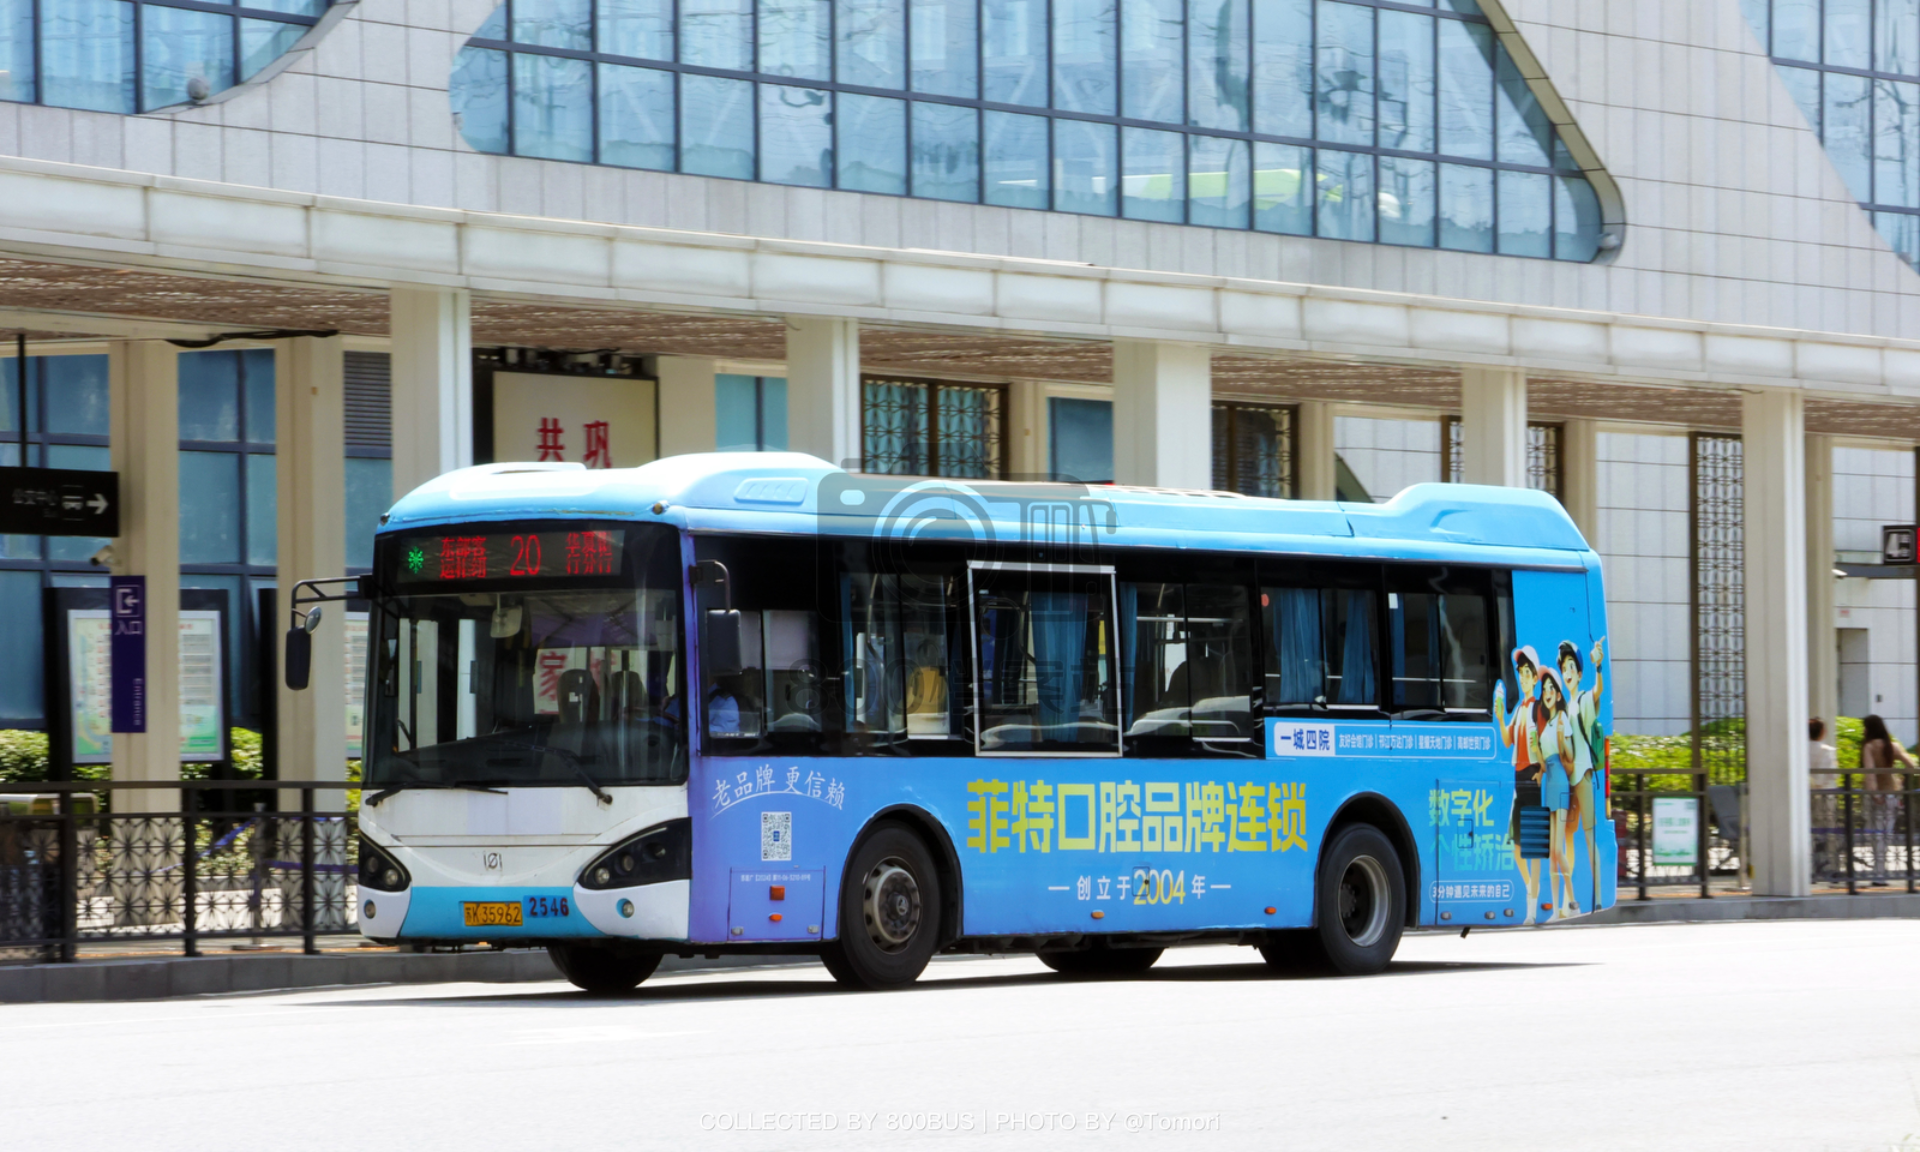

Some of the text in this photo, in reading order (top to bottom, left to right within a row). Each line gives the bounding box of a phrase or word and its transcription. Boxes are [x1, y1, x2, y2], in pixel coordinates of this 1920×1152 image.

[510, 534, 541, 575] 20
[565, 553, 613, 575] 行分行
[114, 620, 142, 635] 入口
[1280, 729, 1330, 751] 一城四院
[712, 764, 845, 810] 老品牌 更信赖
[967, 779, 1308, 853] 菲特口腔品牌连锁
[1429, 789, 1494, 827] 数字化
[1429, 833, 1515, 871] 个性矫治
[1432, 884, 1510, 899] 3分钟遇见未来的自己
[529, 897, 569, 917] 2546
